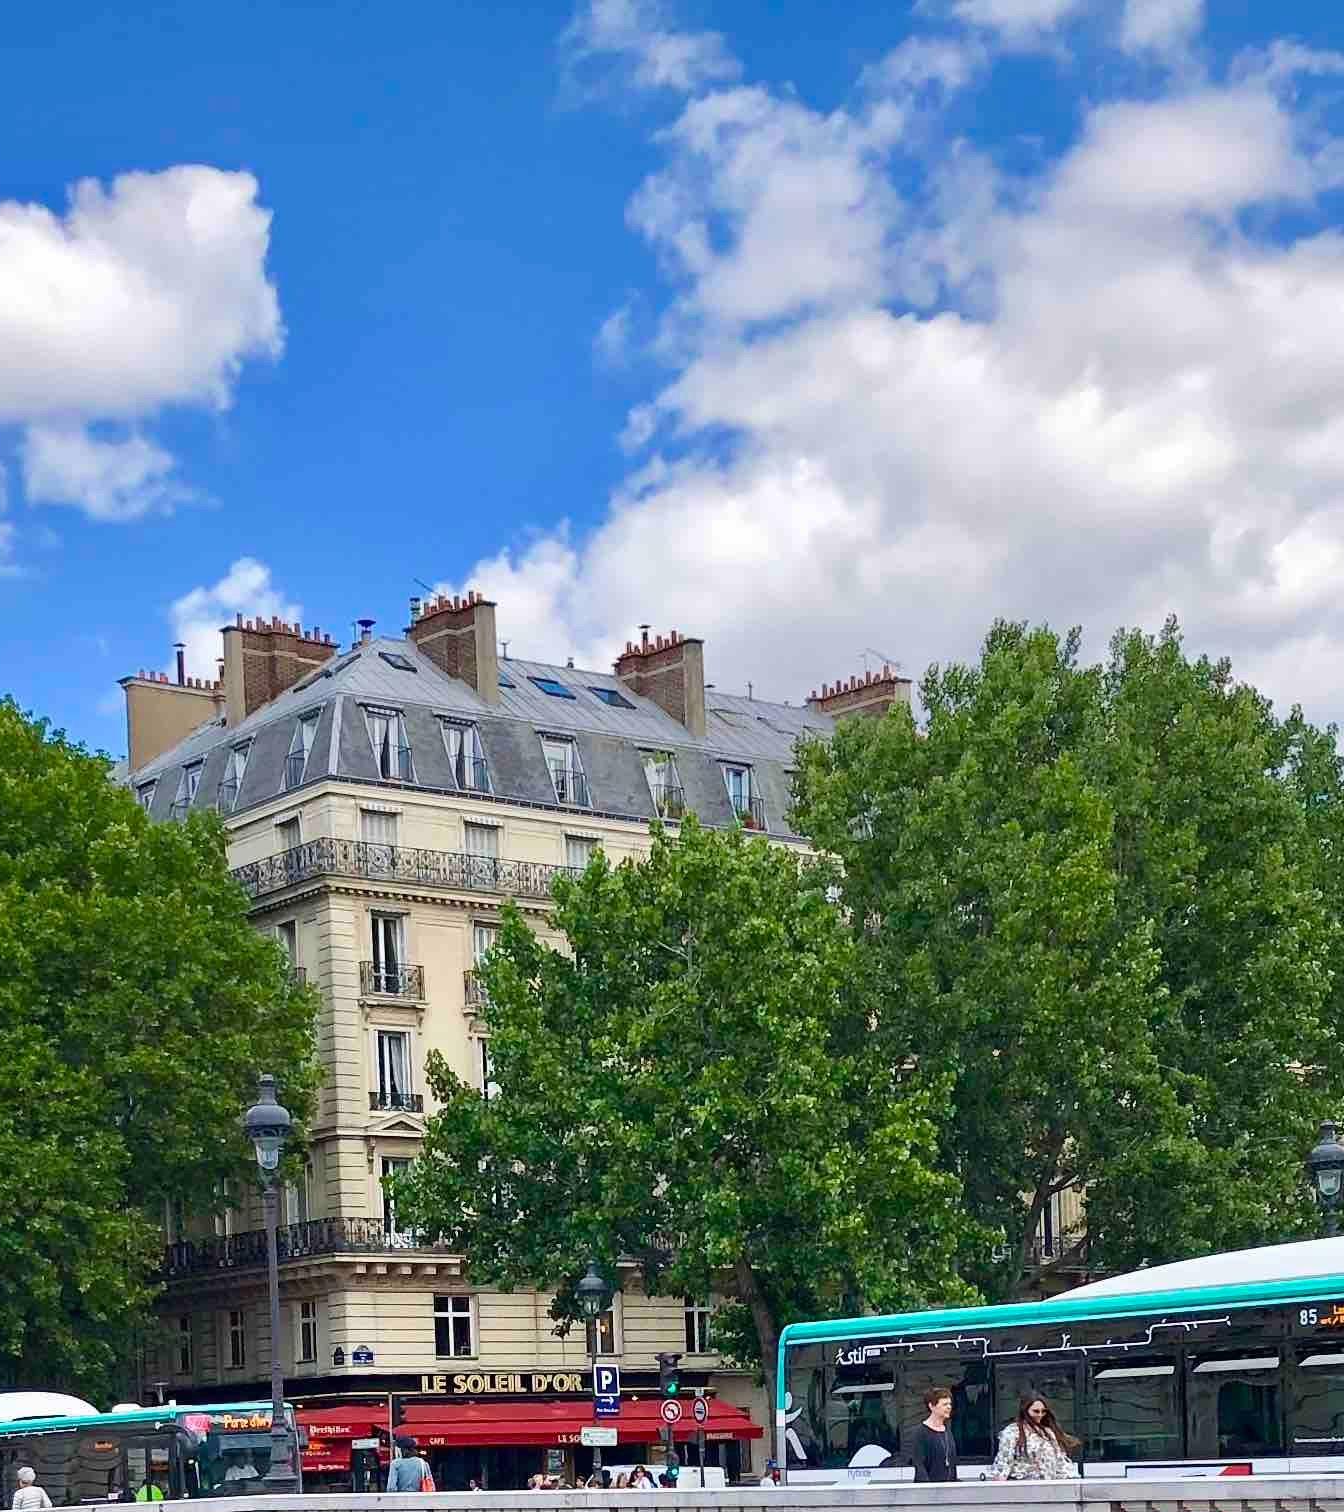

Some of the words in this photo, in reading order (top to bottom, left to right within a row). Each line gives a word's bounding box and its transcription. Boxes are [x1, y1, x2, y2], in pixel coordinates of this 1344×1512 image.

[1299, 1308, 1317, 1325] 85
[421, 1375, 447, 1394] LE
[453, 1373, 527, 1394] SOLEIL
[532, 1373, 583, 1393] D'OR
[601, 1370, 613, 1390] P
